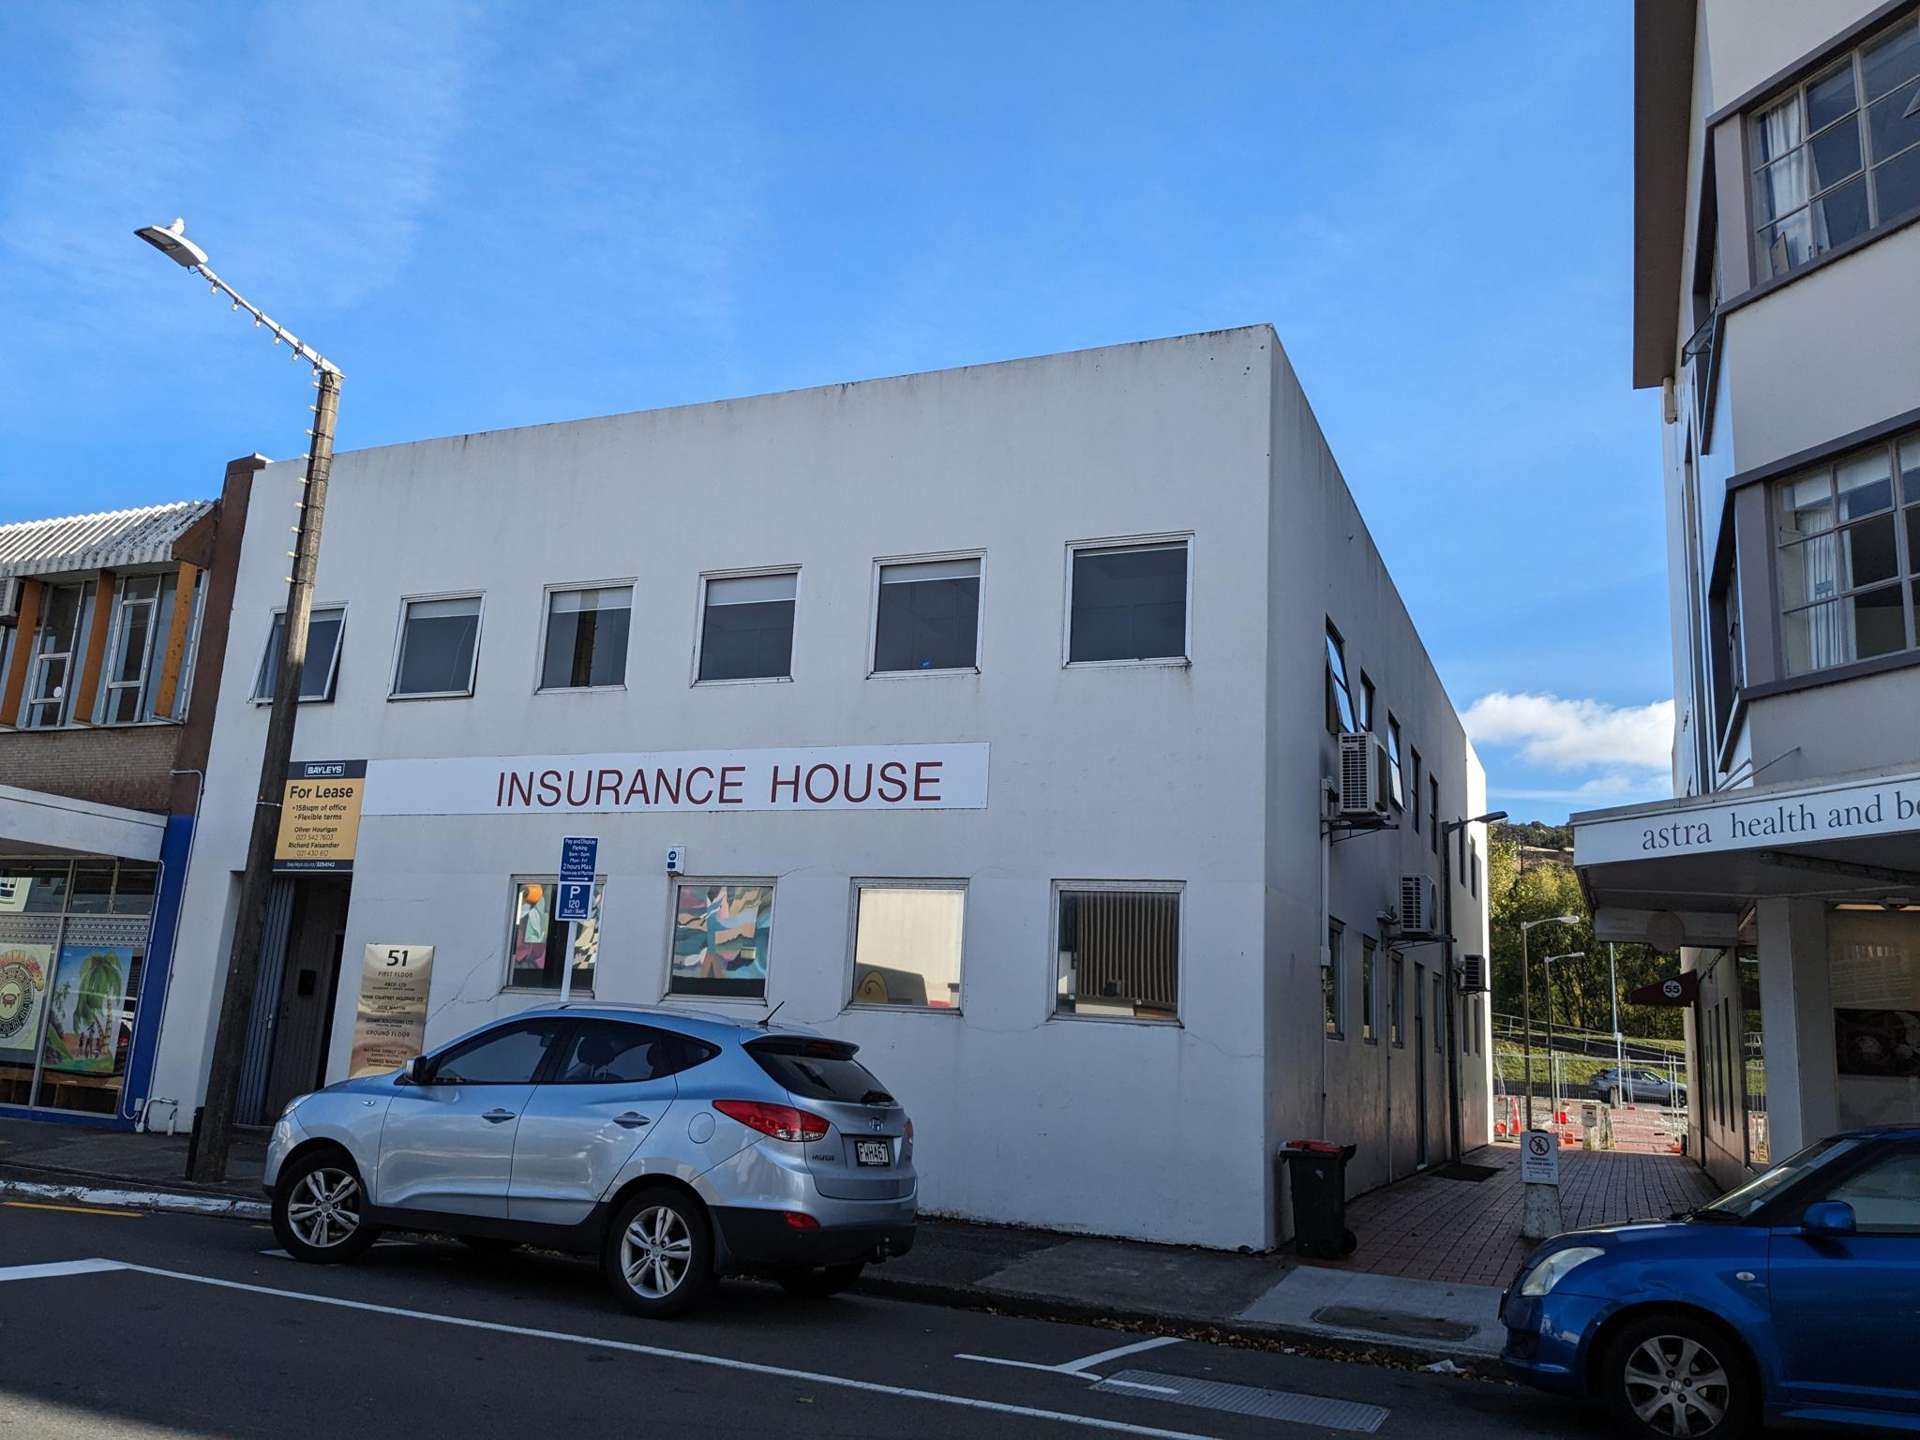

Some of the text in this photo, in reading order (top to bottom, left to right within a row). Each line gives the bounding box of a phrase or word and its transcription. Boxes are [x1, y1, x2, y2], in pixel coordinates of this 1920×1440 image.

[307, 766, 342, 774] BAYLEYS
[496, 761, 943, 807] INSURANCE HOUSE
[289, 785, 354, 799] For Lease
[1643, 823, 1712, 851] astra
[1731, 804, 1816, 839] health
[1827, 794, 1882, 828] and
[570, 886, 581, 899] P
[568, 899, 580, 909] 120
[386, 949, 409, 967] 51
[1664, 984, 1680, 993] 55
